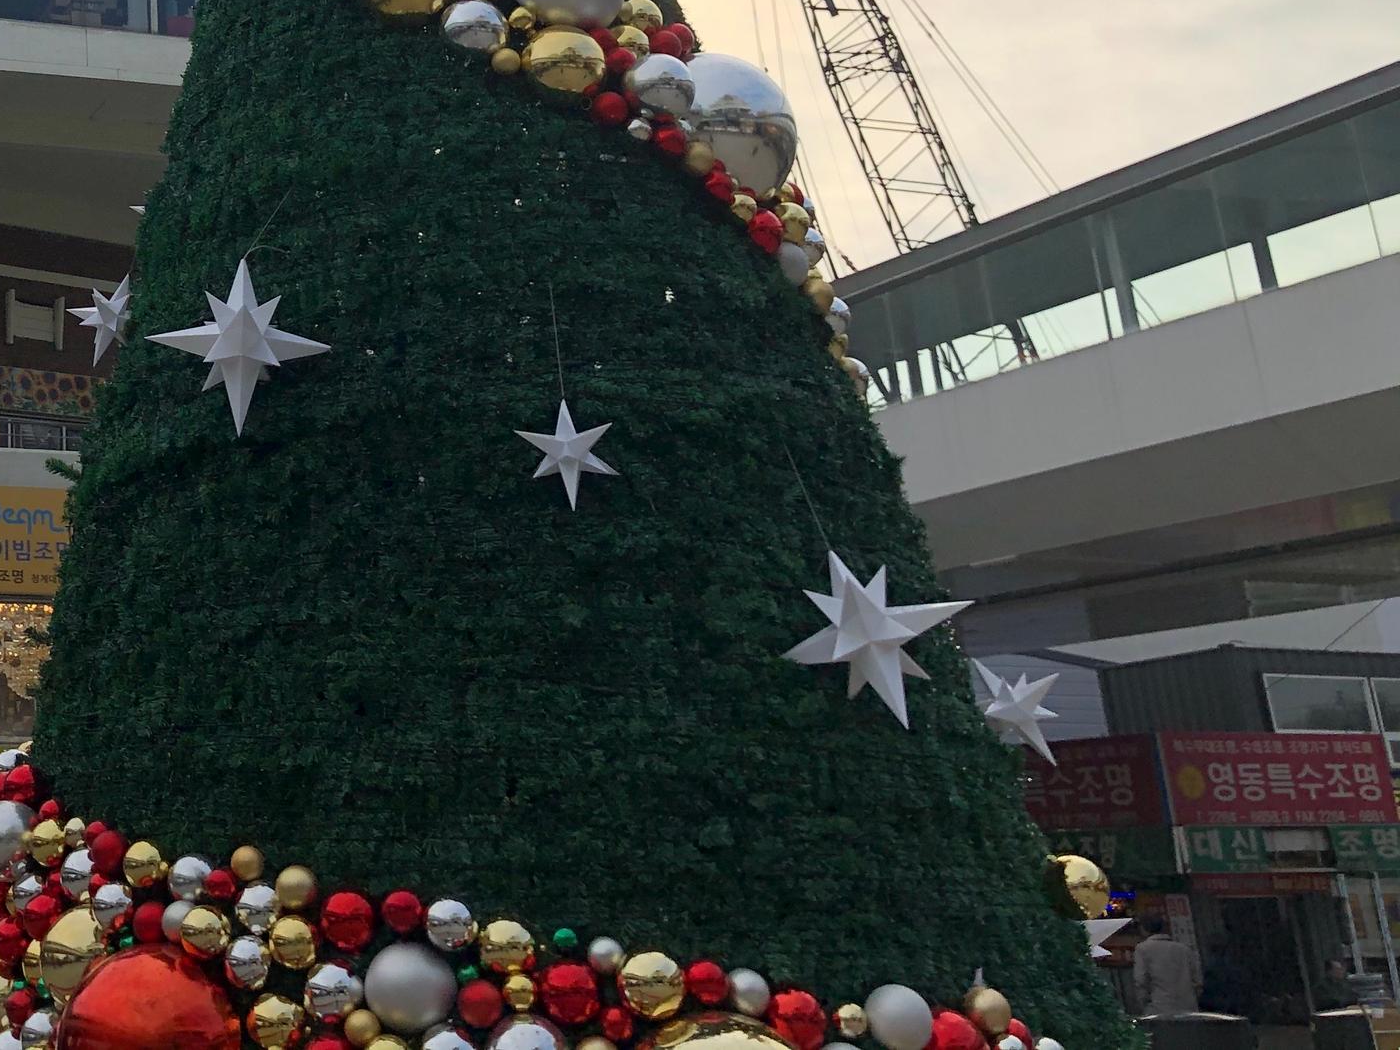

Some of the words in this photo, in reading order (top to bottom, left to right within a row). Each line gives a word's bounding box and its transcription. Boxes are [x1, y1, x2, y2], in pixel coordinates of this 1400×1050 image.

[1207, 762, 1382, 801] 영동특수조명
[1192, 829, 1260, 861] 대신
[1336, 828, 1400, 861] 조명
